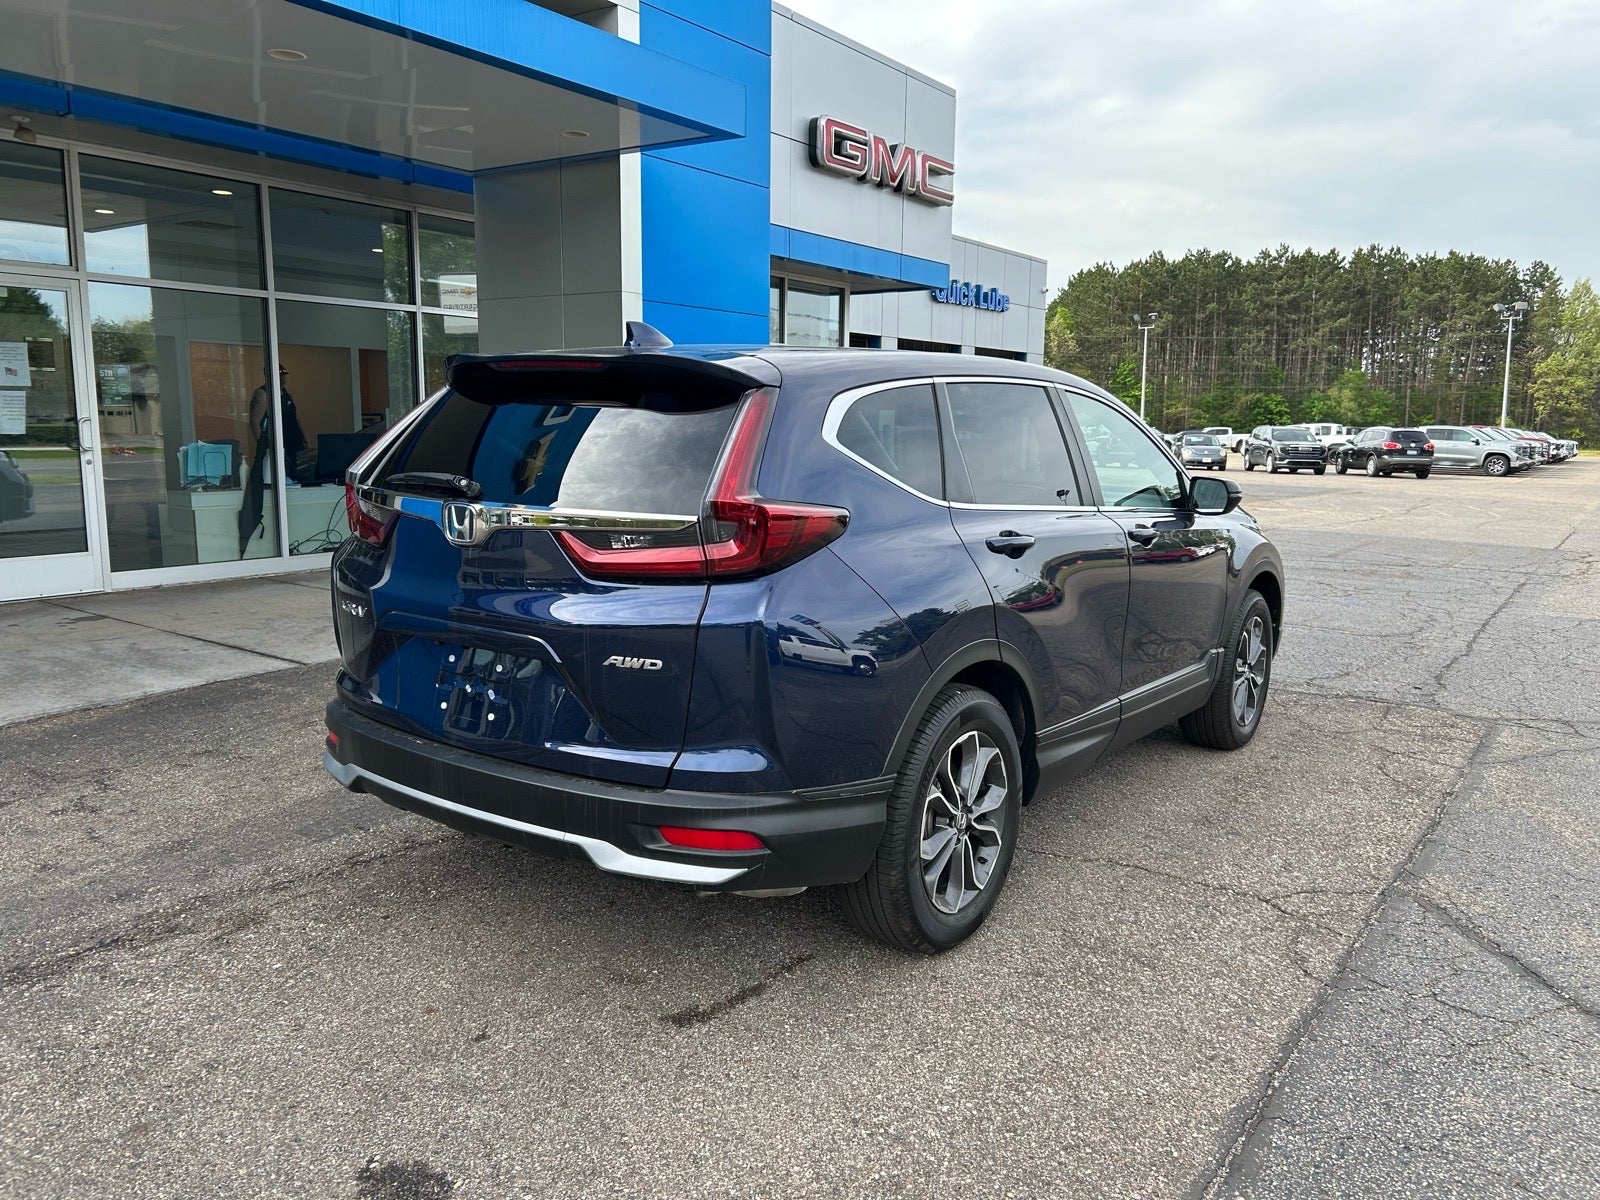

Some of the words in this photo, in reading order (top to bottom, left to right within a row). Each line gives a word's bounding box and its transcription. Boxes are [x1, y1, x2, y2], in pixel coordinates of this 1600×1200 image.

[809, 115, 955, 206] GMC
[933, 281, 977, 307] Quick
[977, 285, 1010, 312] Lube
[601, 655, 663, 670] AWD
